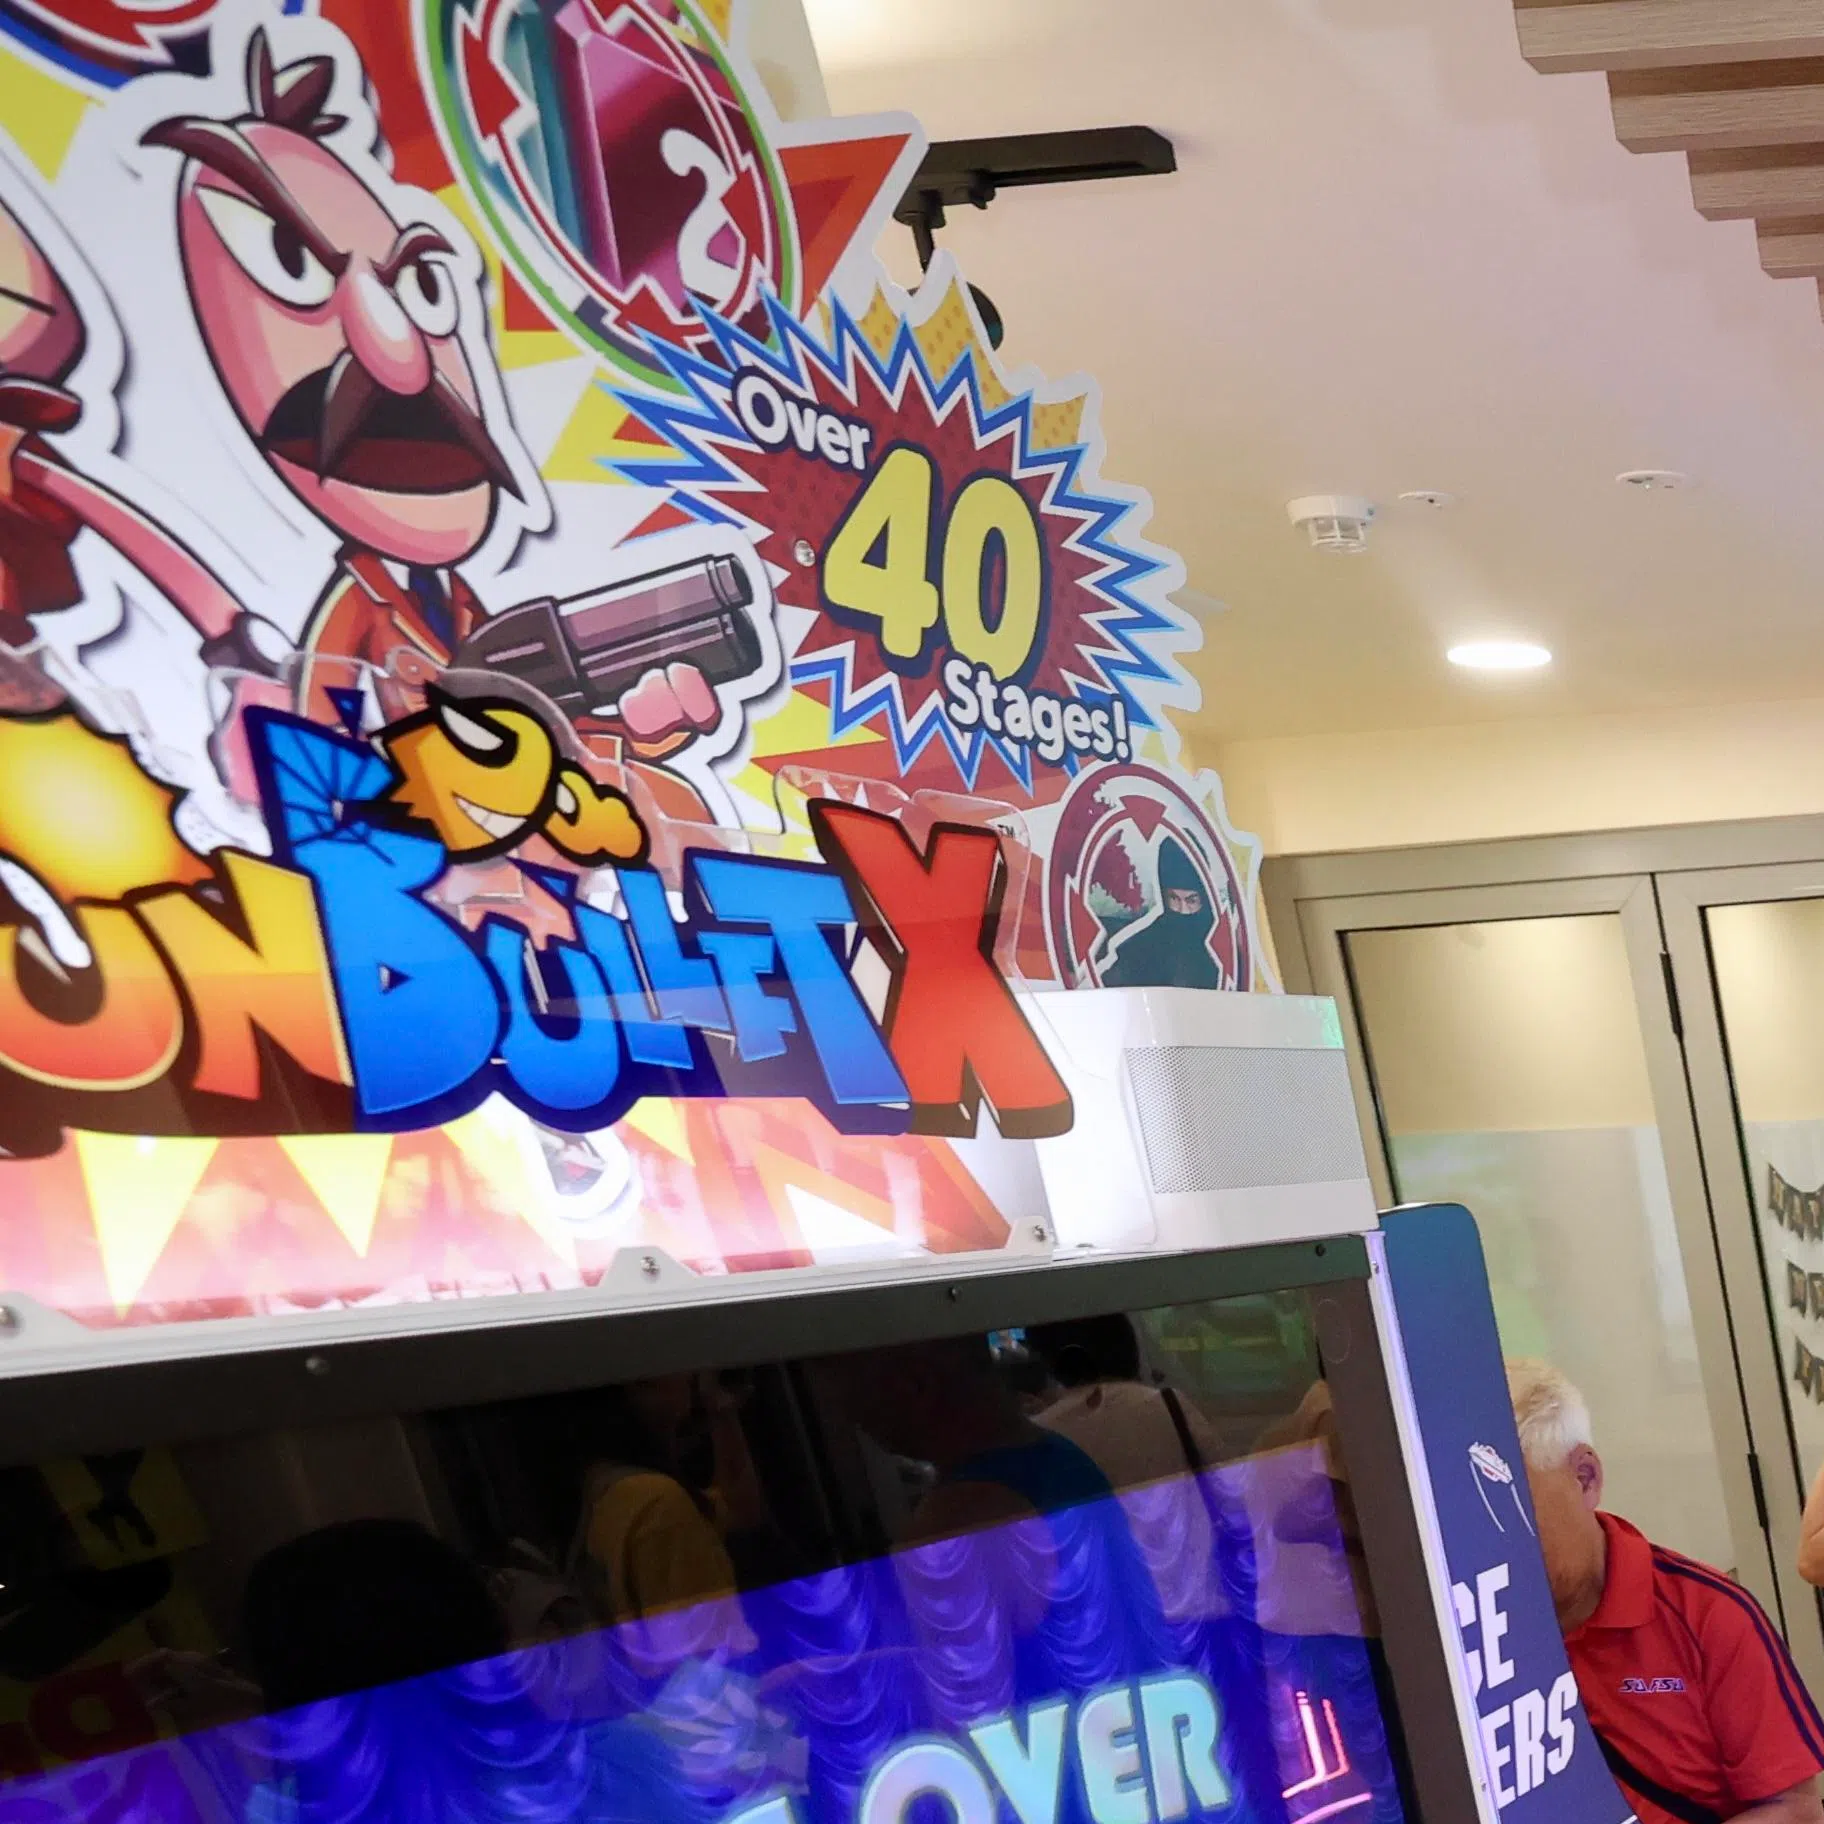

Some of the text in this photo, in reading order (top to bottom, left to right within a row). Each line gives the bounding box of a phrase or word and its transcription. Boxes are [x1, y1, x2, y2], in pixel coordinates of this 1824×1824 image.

[734, 371, 872, 470] Over
[823, 447, 1043, 681] 40
[943, 659, 1129, 760] Stages!
[808, 797, 1076, 1138] X
[1480, 1670, 1579, 1810] ERS
